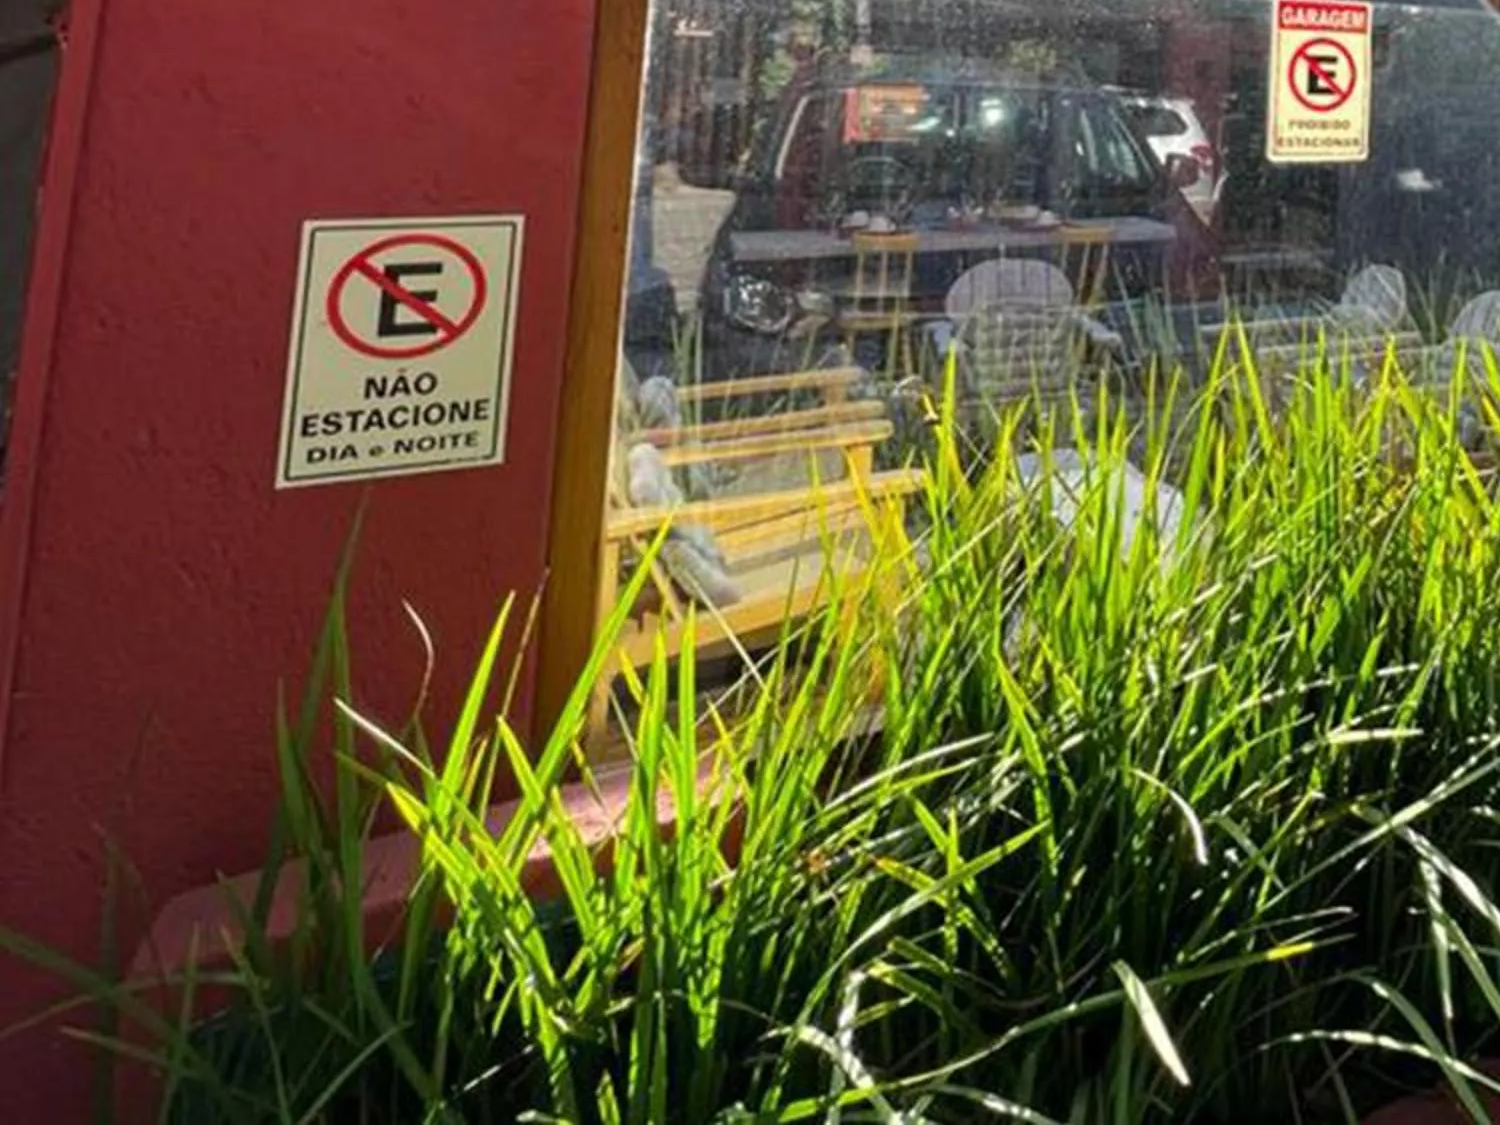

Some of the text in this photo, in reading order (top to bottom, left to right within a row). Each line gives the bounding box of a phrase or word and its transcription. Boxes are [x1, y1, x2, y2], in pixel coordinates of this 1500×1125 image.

[1281, 6, 1366, 28] GARAGEM
[1307, 56, 1338, 94] E
[378, 262, 443, 337] E
[363, 367, 438, 400] NÃO
[301, 398, 491, 438] ESTACIONE
[306, 444, 359, 465] DIA
[393, 431, 480, 455] NOITE
